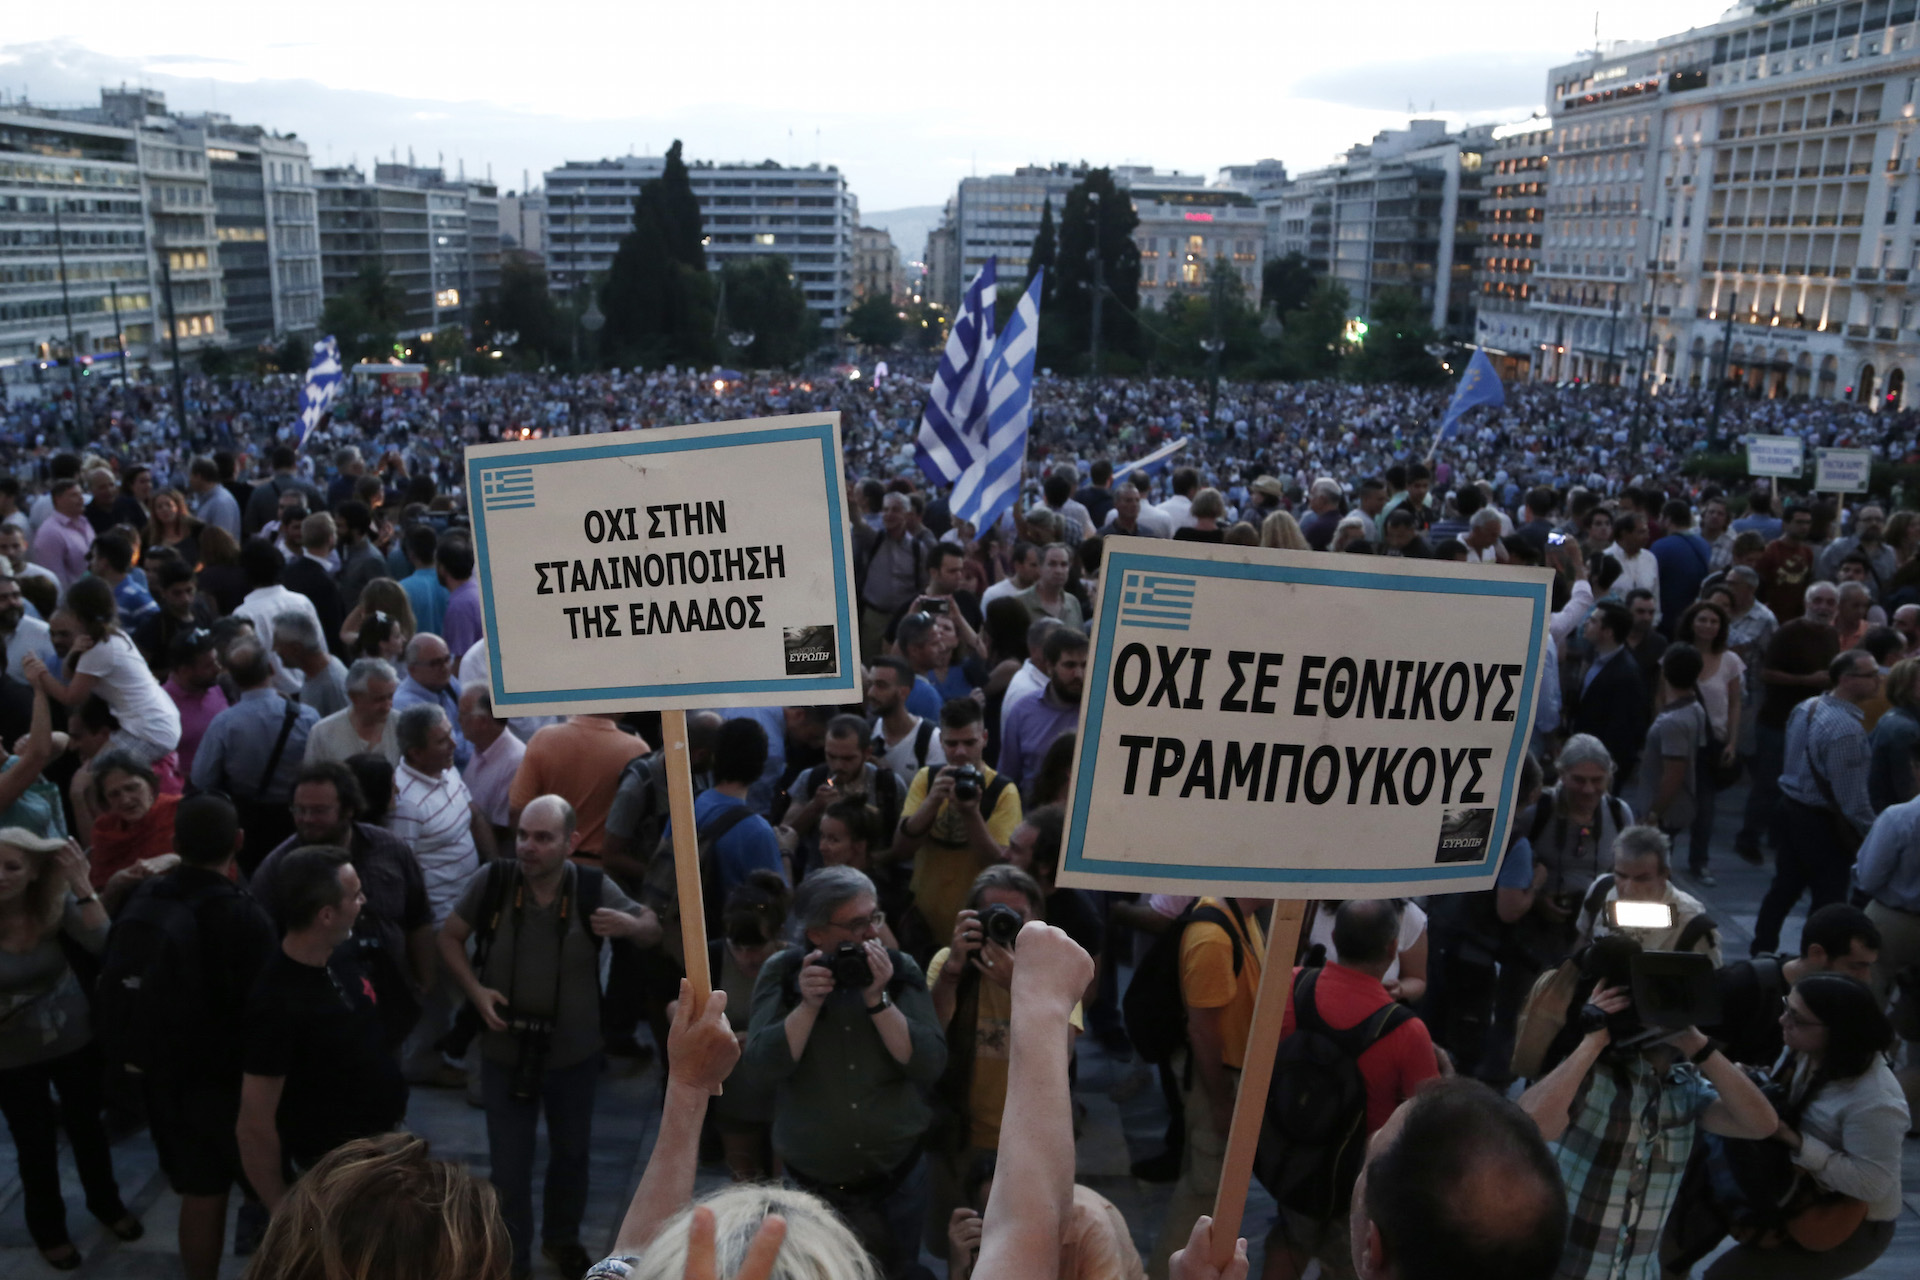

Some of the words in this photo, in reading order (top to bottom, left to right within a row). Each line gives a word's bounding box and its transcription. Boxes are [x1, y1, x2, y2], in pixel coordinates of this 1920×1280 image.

[585, 508, 638, 543] ΟΧΙ
[647, 500, 727, 539] ΣΤΗΝ
[534, 545, 786, 595] ΣΤΑΛΙΝΟΠΟΙΗΣΗ
[563, 604, 622, 639] ΤΗΣ
[630, 595, 766, 636] ΕΛΛΑΔΟΣ
[789, 652, 830, 662] ΕΥΡΩΠΗ
[1113, 643, 1211, 709] ΟΧΙ
[1219, 651, 1285, 714] ΣΕ
[1293, 656, 1523, 722] ΕΘΝΙΚΟΥΣ
[1118, 735, 1493, 806] ΤΡΑΜΠΟΥΚΟΥΣ
[1441, 837, 1483, 849] ΕΥΡΩΠΗ
